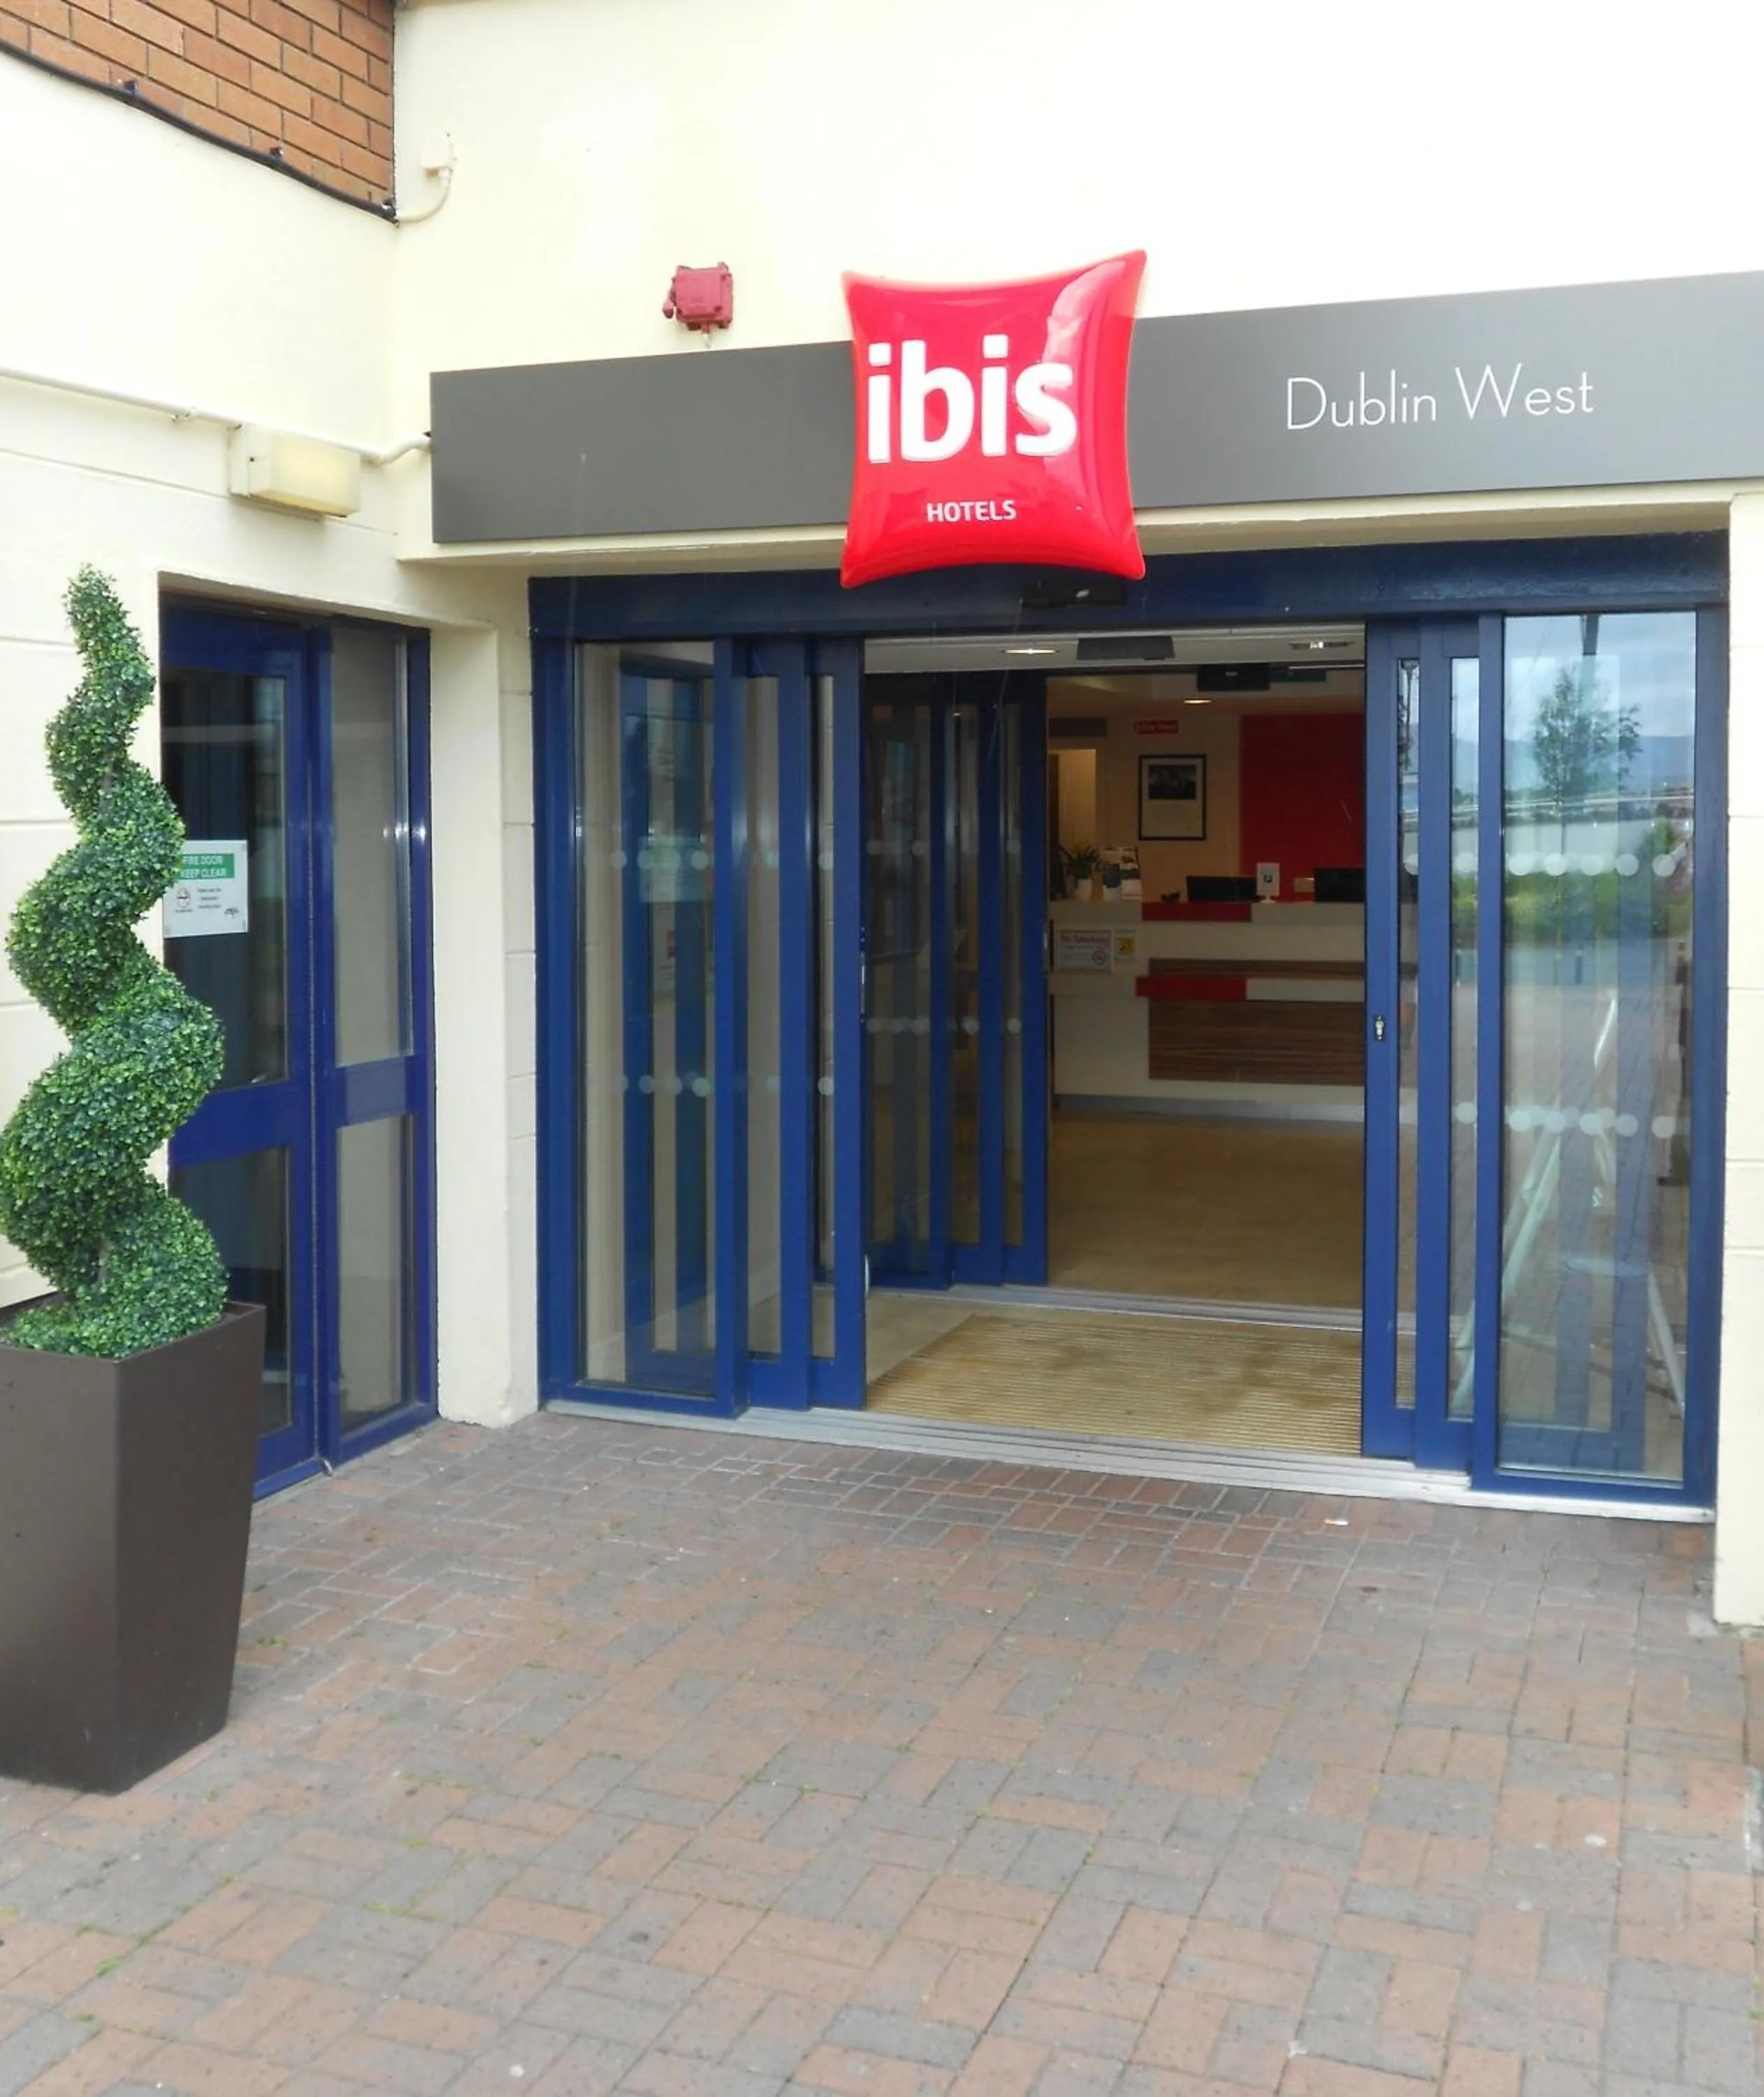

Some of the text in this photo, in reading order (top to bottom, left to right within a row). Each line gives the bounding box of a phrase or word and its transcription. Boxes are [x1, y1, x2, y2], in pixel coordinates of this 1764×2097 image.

[867, 333, 1077, 463] ibis
[1287, 362, 1594, 430] Dublin West
[926, 499, 1017, 523] HOTELS
[201, 855, 223, 865] DOOR
[180, 867, 227, 879] KEEP CLEAR
